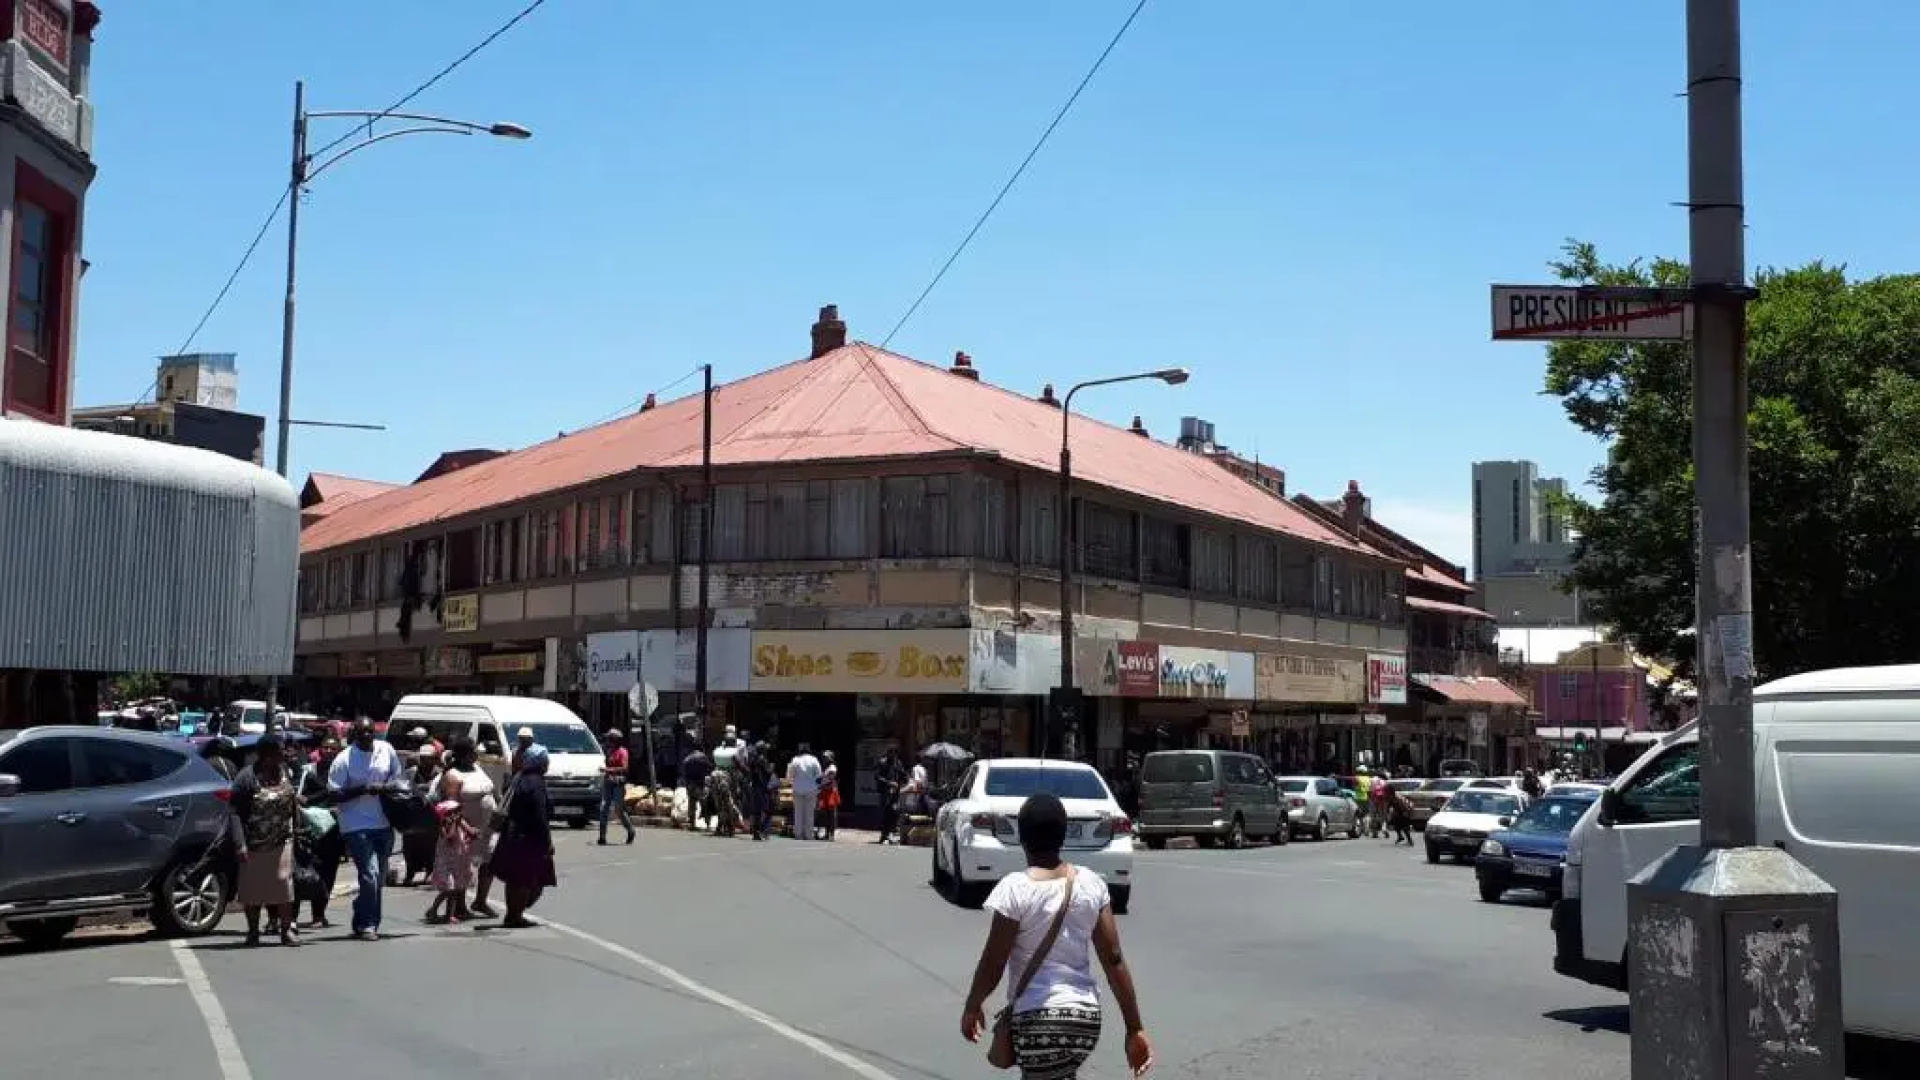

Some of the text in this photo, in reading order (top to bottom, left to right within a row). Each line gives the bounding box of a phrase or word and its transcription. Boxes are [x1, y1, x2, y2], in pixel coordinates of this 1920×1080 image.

[1509, 295, 1629, 332] PRESIDENT
[753, 644, 833, 677] Shoe
[898, 644, 965, 678] Box
